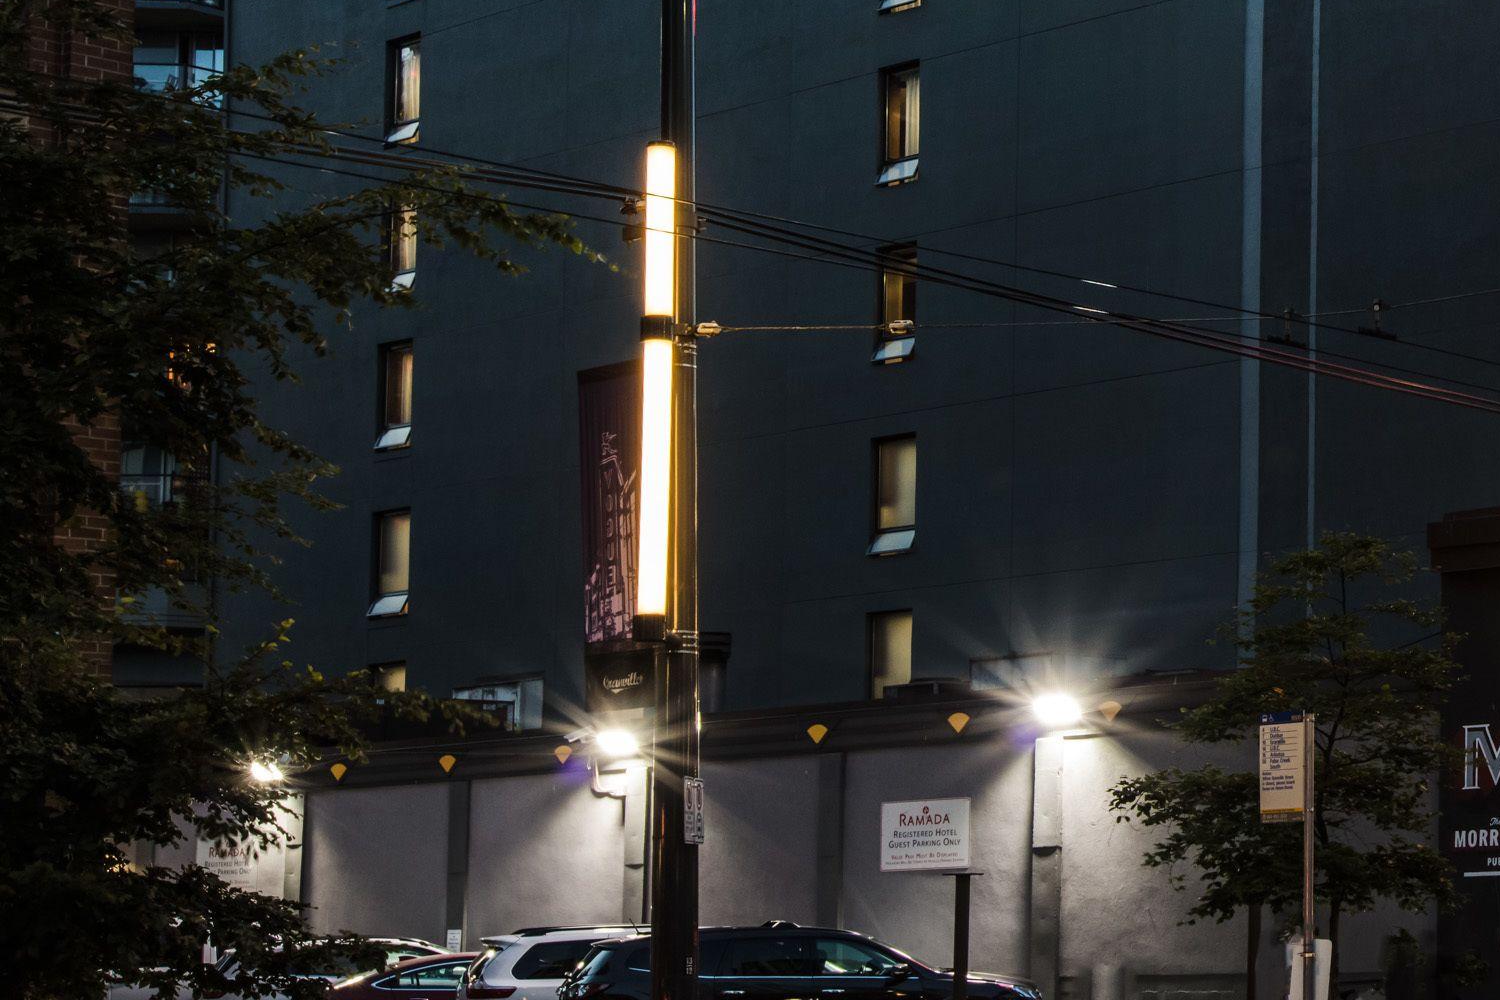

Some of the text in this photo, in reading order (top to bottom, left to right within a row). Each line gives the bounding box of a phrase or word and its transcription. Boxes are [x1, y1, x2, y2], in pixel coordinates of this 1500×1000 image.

[899, 813, 950, 827] RAMADA
[893, 828, 958, 839] REGISTERED HOTEL
[888, 837, 961, 849] GUEST PARKING ONLY
